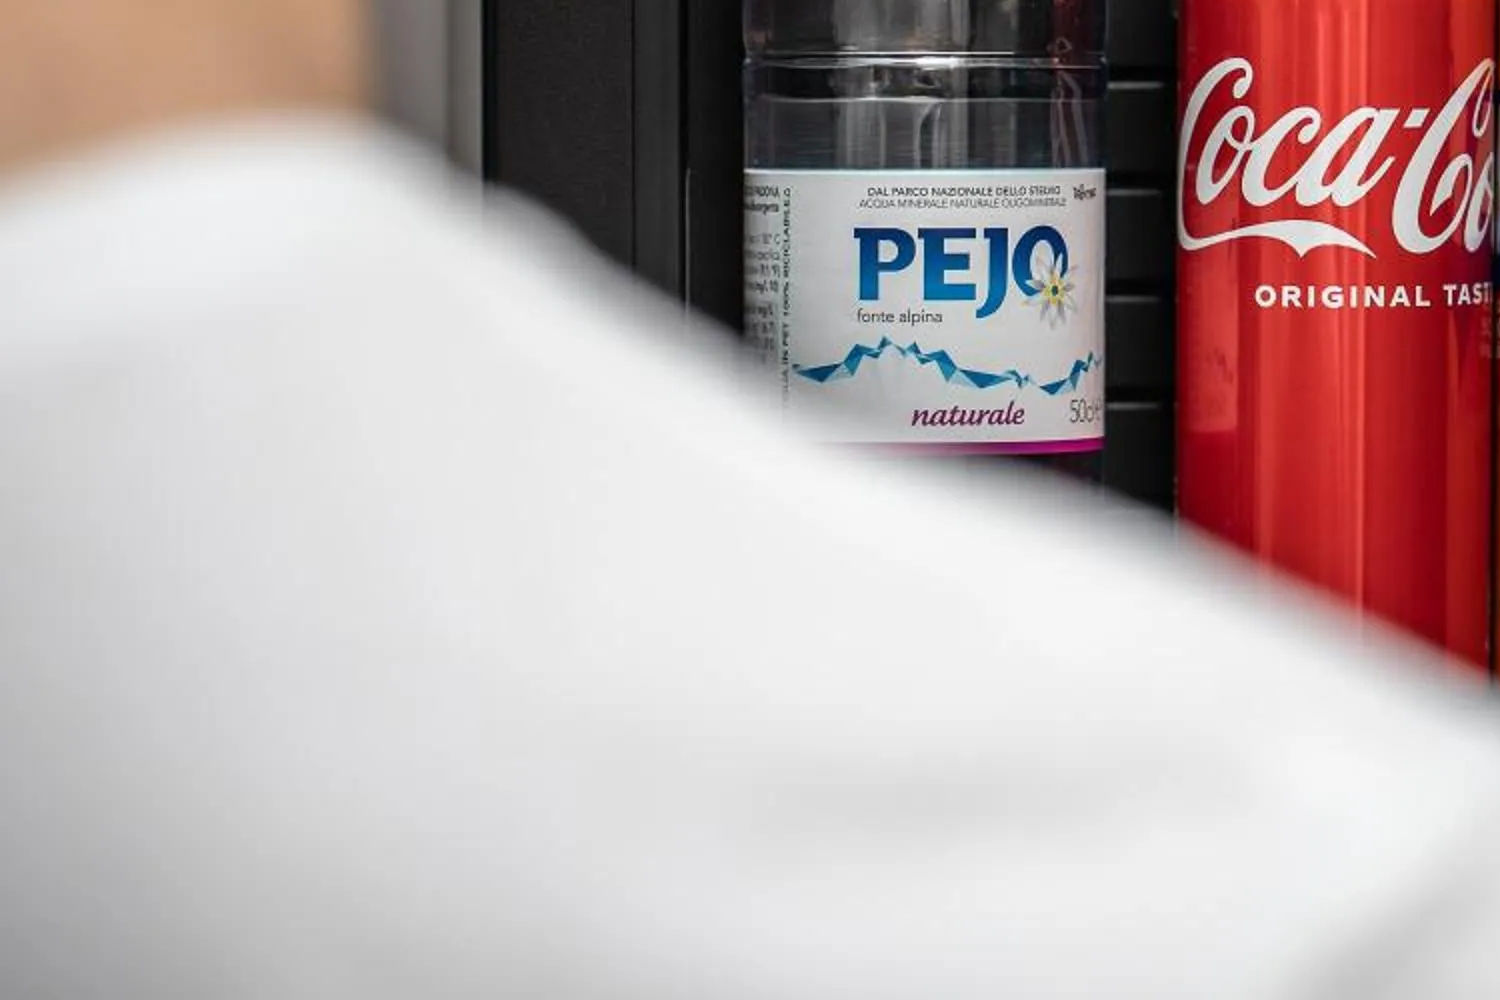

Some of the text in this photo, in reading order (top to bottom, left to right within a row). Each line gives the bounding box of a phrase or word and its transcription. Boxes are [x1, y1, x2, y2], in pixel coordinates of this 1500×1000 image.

[867, 186, 889, 197] DAL
[891, 186, 929, 197] PARCO
[931, 186, 993, 197] NAZIONALE
[853, 225, 1069, 319] PEJO
[1255, 285, 1431, 308] ORIGINAL
[856, 308, 944, 327] fonte alpina
[911, 400, 1026, 427] naturale
